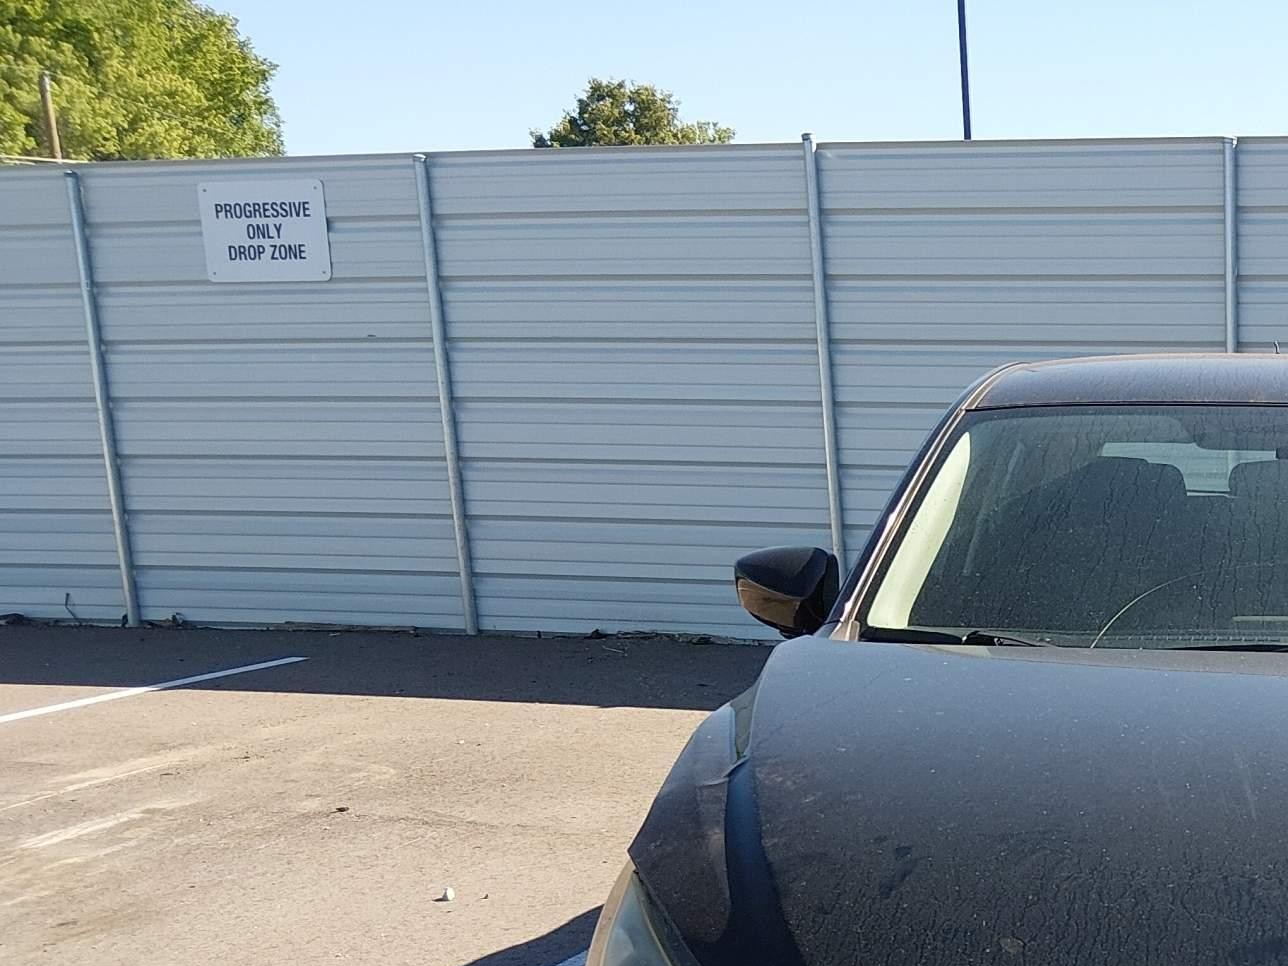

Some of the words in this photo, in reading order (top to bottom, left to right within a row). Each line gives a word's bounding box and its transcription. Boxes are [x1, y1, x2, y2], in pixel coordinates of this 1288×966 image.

[214, 201, 311, 219] PROGRESSIVE
[246, 223, 282, 240] ONLY
[228, 244, 266, 261] DROP
[269, 243, 307, 260] ZONE
